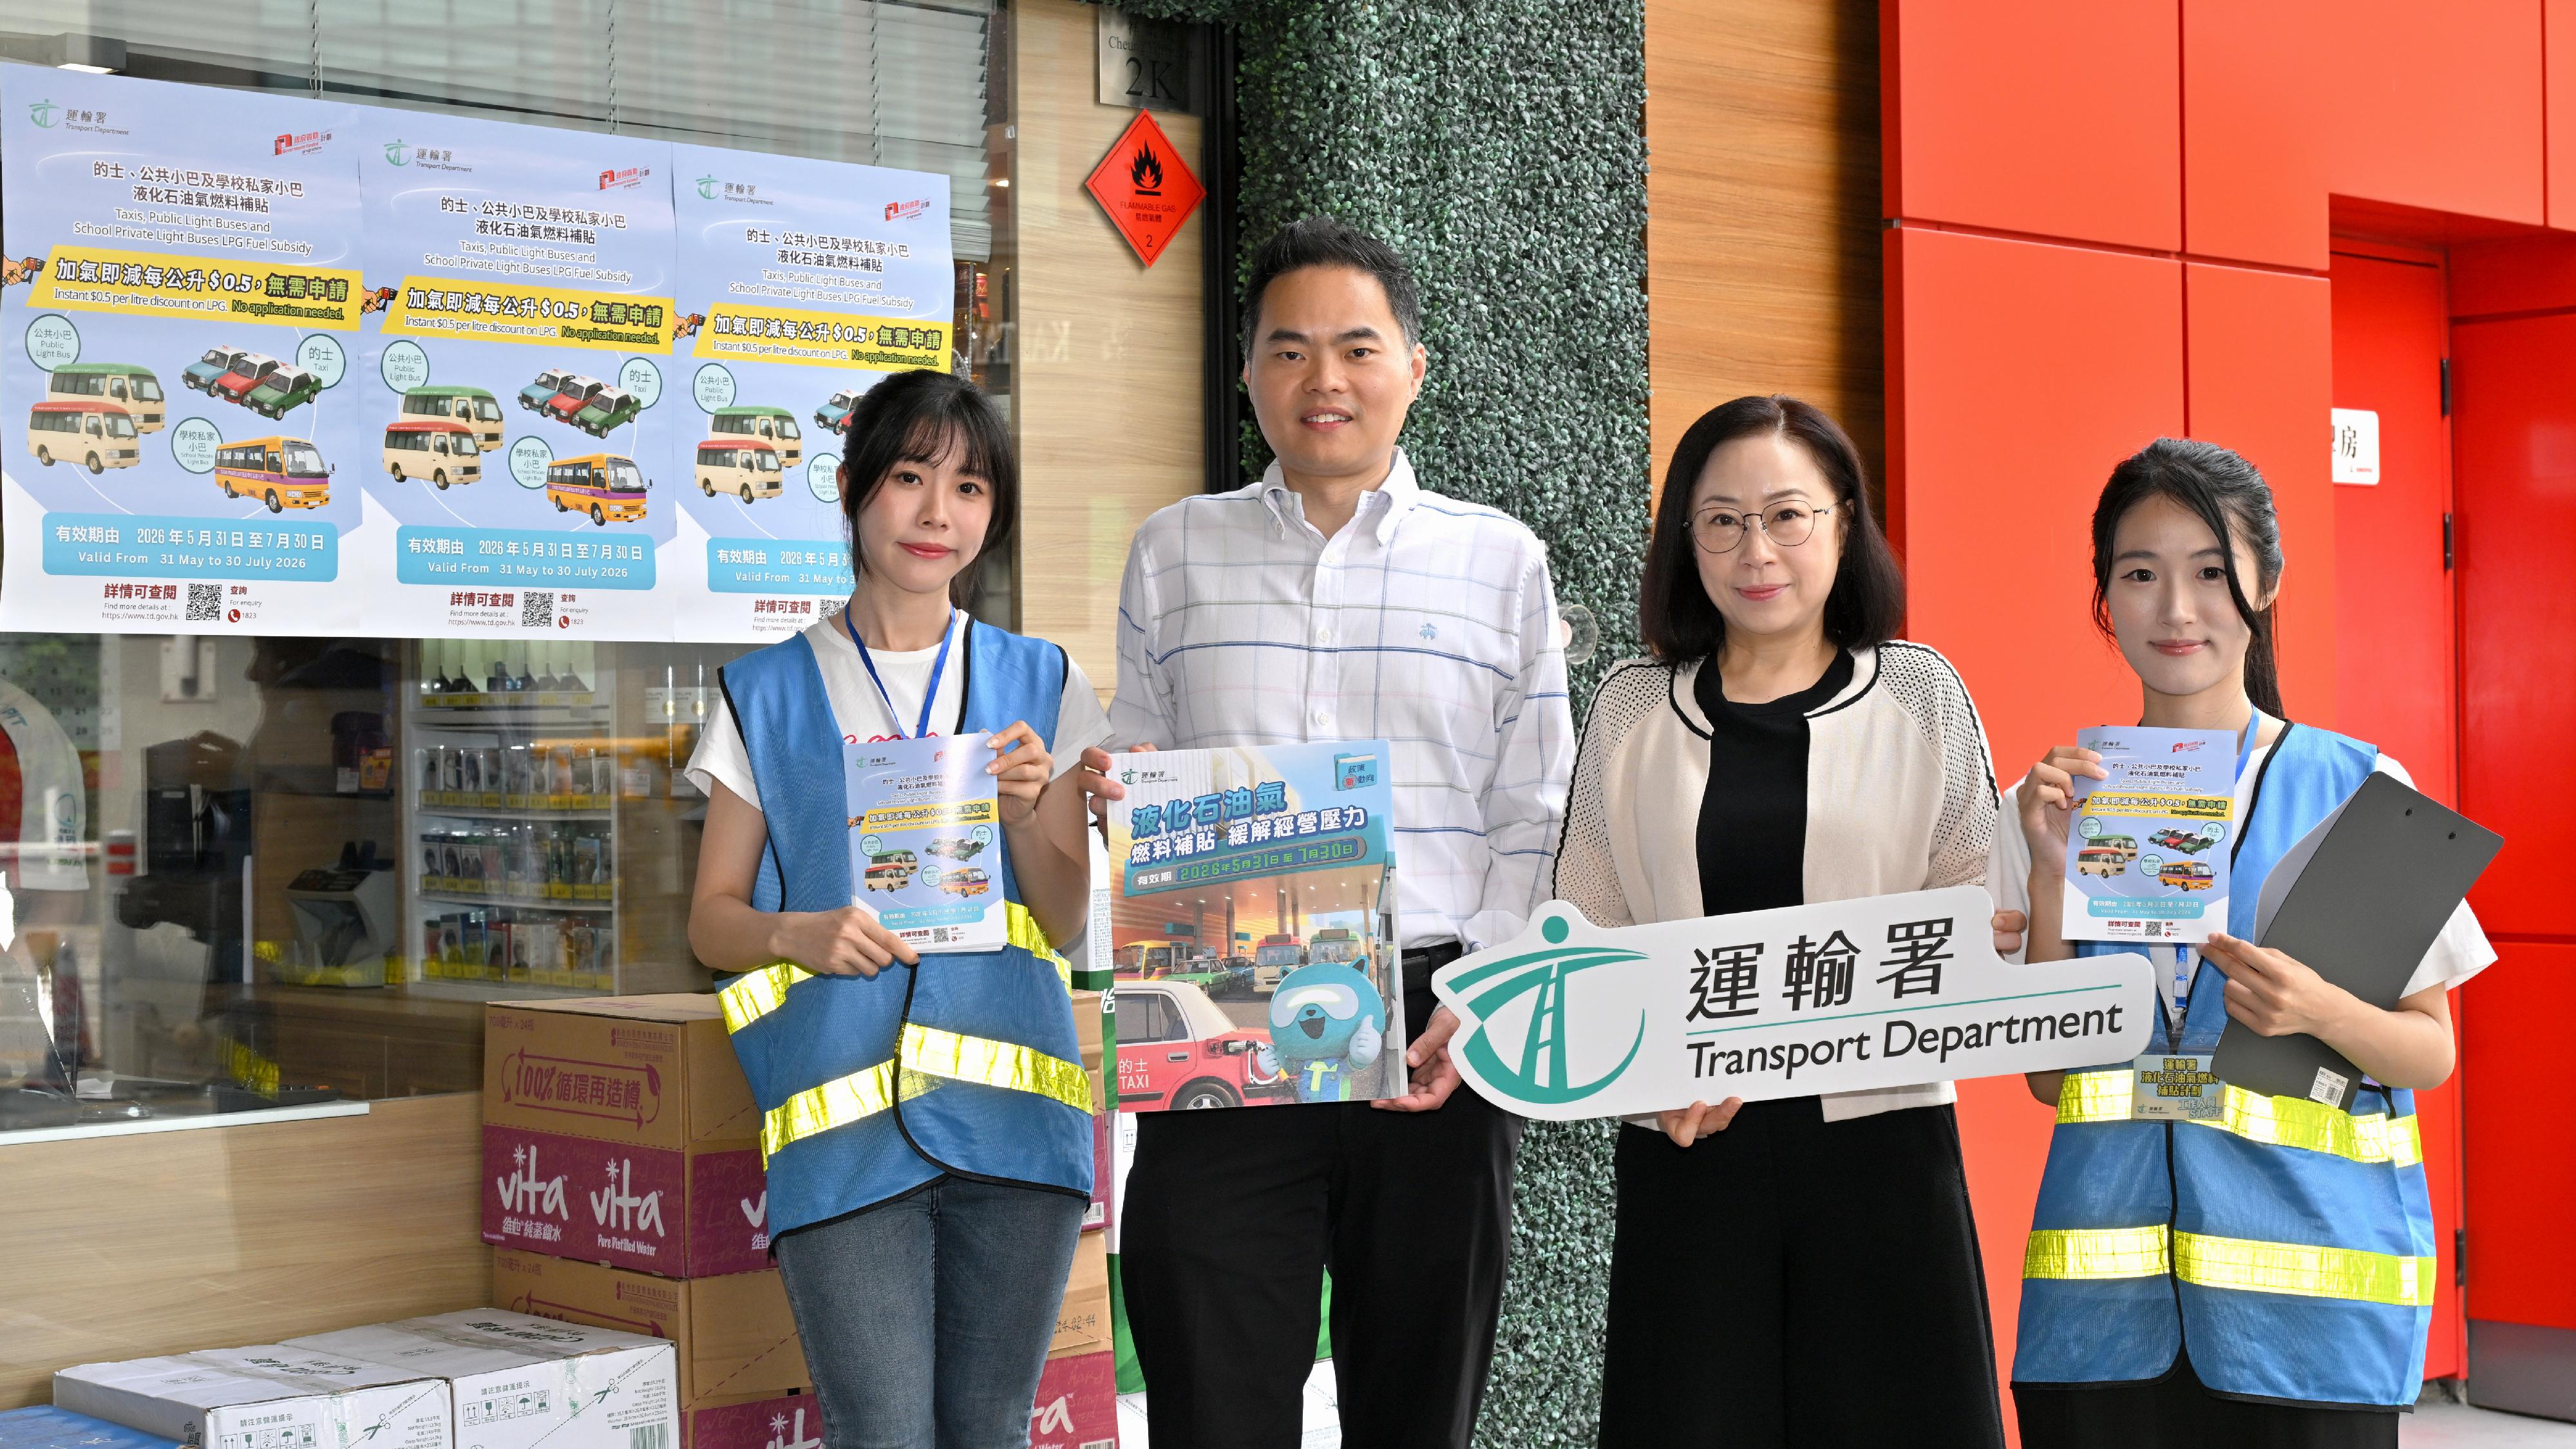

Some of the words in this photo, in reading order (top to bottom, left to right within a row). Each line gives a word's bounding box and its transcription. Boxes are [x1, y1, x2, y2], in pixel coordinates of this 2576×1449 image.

[1126, 57, 1178, 100] 2K
[66, 109, 106, 124] 運輸署
[66, 123, 93, 132] Transport
[95, 126, 129, 135] Department
[417, 148, 452, 162] 運輸署
[93, 161, 304, 198] 的士、公共小巴及學校私家小巴
[724, 182, 755, 195] 運輸署
[133, 185, 269, 214] 液化石油氣燃料補貼
[1120, 201, 1160, 211] FLAMMABLE
[116, 209, 146, 222] Taxis,
[149, 211, 182, 225] Public
[185, 214, 213, 229] Light
[216, 216, 247, 231] Buses
[250, 220, 270, 232] and
[441, 197, 626, 229] 的士、公共小巴及學校私家小巴
[1135, 213, 1162, 223] 易燃氣體
[74, 222, 112, 236] School
[115, 227, 153, 240] Private
[156, 229, 184, 243] Light
[187, 232, 219, 246] Buses
[222, 235, 243, 247] LPG
[246, 237, 268, 250] Fuel
[270, 239, 312, 256] Subsidy
[476, 220, 595, 245] 液化石油氣燃料補貼
[747, 229, 909, 258] 的士、公共小巴及學校私家小巴
[1146, 235, 1153, 247] 2
[460, 242, 486, 254] Taxis,
[490, 245, 518, 256] Public
[521, 247, 545, 260] Light
[548, 250, 575, 261] Buses
[578, 252, 595, 263] and
[778, 251, 882, 272] 液化石油氣燃料補貼
[424, 255, 457, 267] School
[460, 259, 493, 270] Private
[497, 261, 520, 274] Light
[523, 263, 550, 275] Buses
[553, 267, 571, 277] LPG
[574, 268, 593, 279] Fuel
[596, 270, 631, 284] Subsidy
[54, 289, 88, 301] Instant
[90, 290, 111, 303] $0.5
[113, 293, 129, 305] per
[131, 294, 148, 305] litre
[150, 296, 192, 308] discount
[192, 299, 204, 309] on
[207, 299, 227, 312] LPG.
[232, 300, 247, 313] No
[249, 302, 303, 317] application
[305, 306, 345, 319] needed.
[34, 328, 72, 340] 公共小巴
[41, 341, 64, 349] Public
[36, 348, 55, 359] Light
[57, 350, 70, 359] Bus
[308, 346, 334, 361] 的士
[389, 354, 422, 364] 公共小巴
[314, 363, 329, 372] Taxi
[630, 369, 651, 383] 的士
[700, 376, 729, 385] 公共小巴
[179, 431, 215, 441] 學校私家
[189, 442, 207, 452] 小巴
[516, 448, 547, 459] 學校私家
[524, 459, 540, 469] 小巴
[821, 475, 835, 483] 小巴
[56, 526, 120, 544] 有效期由
[408, 538, 464, 554] 有效期由
[78, 551, 111, 564] Valid
[116, 553, 148, 564] From
[160, 554, 174, 565] 31
[179, 554, 204, 567] May
[209, 556, 222, 566] to
[226, 556, 241, 567] 30
[245, 556, 272, 569] July
[275, 558, 306, 569] 2026
[717, 549, 767, 565] 有效期由
[735, 572, 761, 582] Valid
[764, 573, 789, 582] From
[799, 574, 810, 583] 31
[813, 574, 833, 584] May
[104, 583, 177, 600] 詳情可查閱
[231, 585, 247, 595] 查詢
[450, 592, 514, 607] 詳情可查閱
[561, 594, 575, 603] 查詢
[754, 600, 811, 613] 詳情可查閱
[1348, 764, 1365, 773] 政策
[1131, 781, 1288, 838] 液化石油氣
[1130, 831, 1217, 866] 燃料補貼
[1227, 806, 1368, 847] 緩解經營壓力
[1137, 871, 1172, 886] 有效期
[1687, 916, 1955, 1023] 運輸署
[1687, 1029, 1870, 1080] Transport
[1882, 1004, 2123, 1064] Department
[1119, 1058, 1148, 1074] 的士
[2163, 1058, 2197, 1071] 運輸署
[515, 1065, 556, 1103] 100%
[1119, 1075, 1150, 1090] TAXI
[2157, 1085, 2202, 1097] 補貼計劃
[2177, 1097, 2216, 1110] 工作人員
[2189, 1107, 2223, 1119] STAFF
[497, 1144, 569, 1221] vita
[591, 1158, 665, 1237] vita
[598, 1235, 611, 1249] Pure
[612, 1237, 636, 1254] Distilled
[637, 1242, 656, 1256] Water
